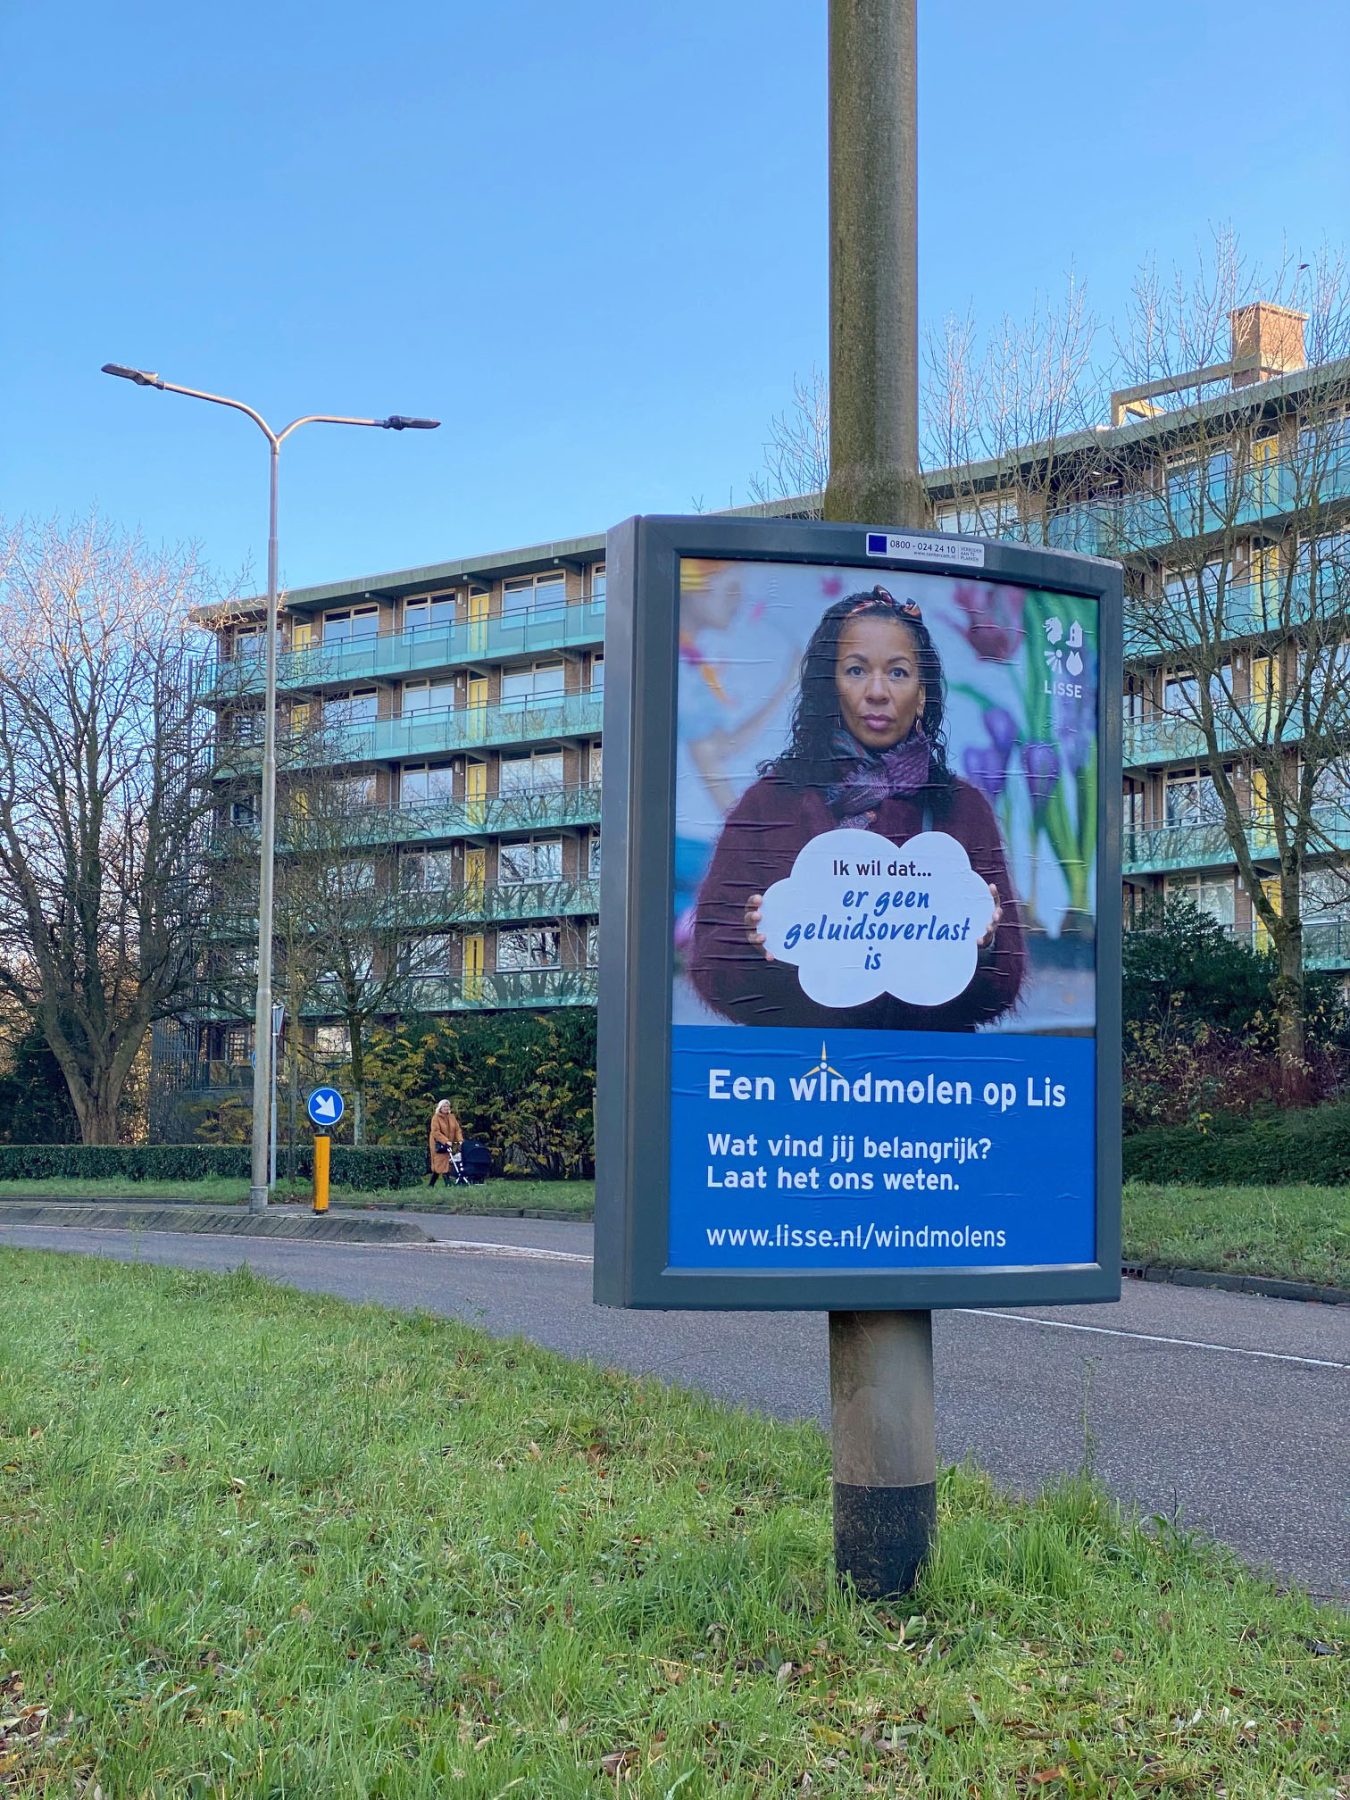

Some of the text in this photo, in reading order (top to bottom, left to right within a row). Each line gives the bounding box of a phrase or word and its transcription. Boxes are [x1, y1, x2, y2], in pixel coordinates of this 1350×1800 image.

[890, 540, 911, 549] 0800
[917, 542, 932, 551] 024
[934, 544, 944, 552] 24
[947, 545, 956, 554] 10
[1044, 680, 1082, 698] LISSE
[833, 860, 932, 877] Ik wil dat...
[842, 890, 930, 917] er geen
[783, 913, 971, 950] geluidsoverlast
[864, 946, 882, 970] is
[708, 1069, 1066, 1113] Een windmolen op Lis
[707, 1133, 992, 1165] Wat vind jij belangrijk?
[707, 1165, 960, 1191] Laat het ons weten.
[706, 1223, 1006, 1250] www.lisse.nl/windmolens
